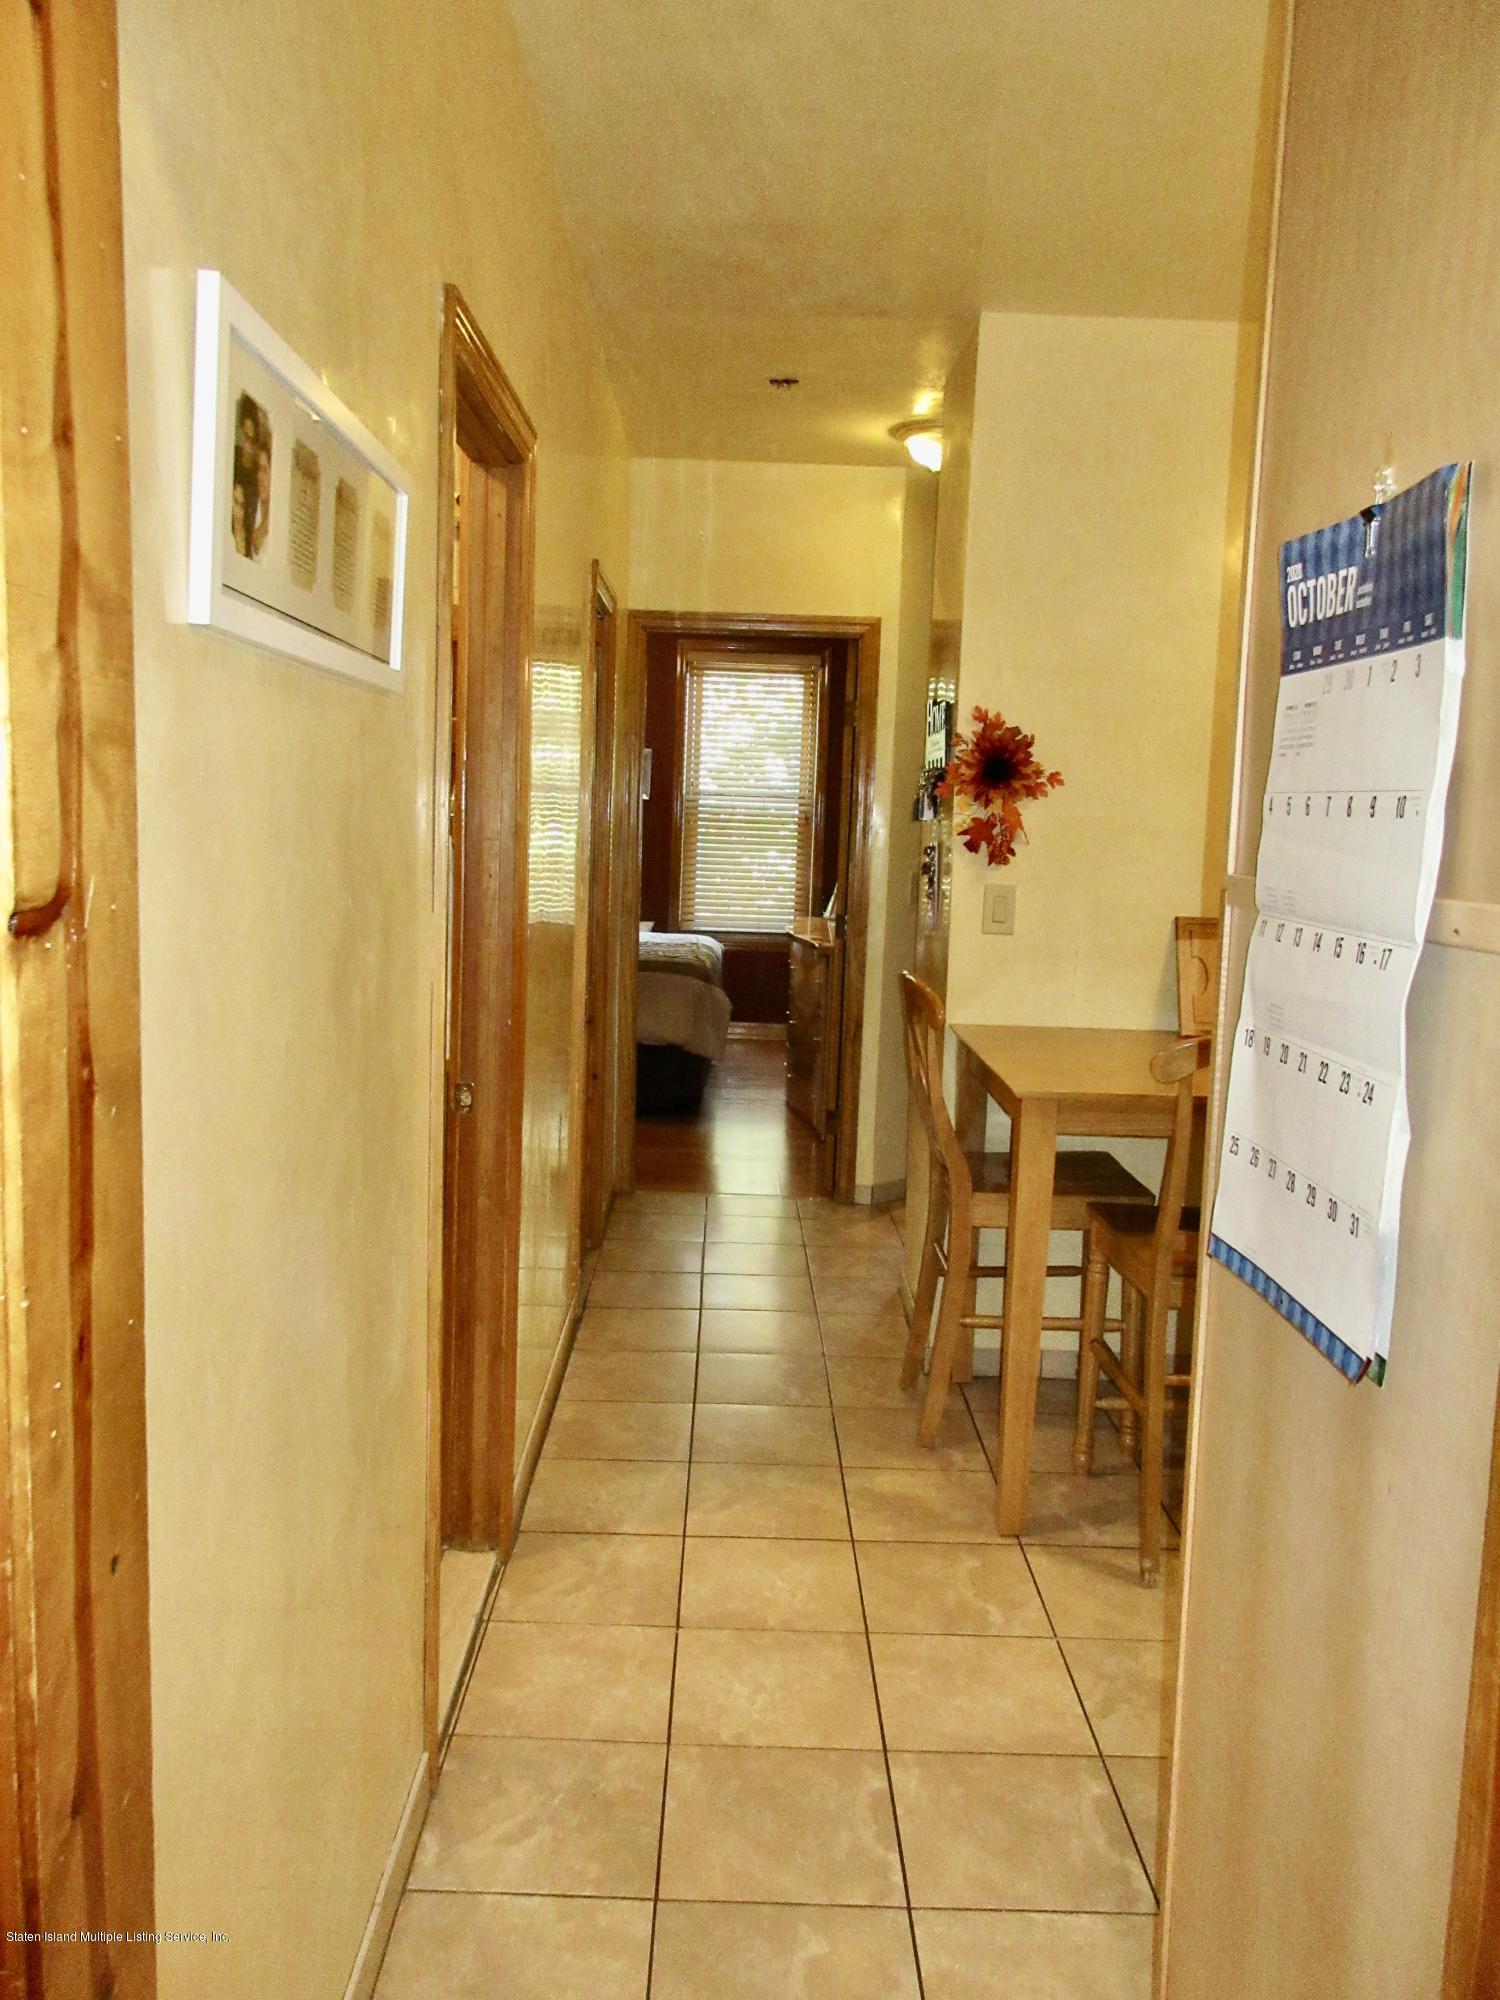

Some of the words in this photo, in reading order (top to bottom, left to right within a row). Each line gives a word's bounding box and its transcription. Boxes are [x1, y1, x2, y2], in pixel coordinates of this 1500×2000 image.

[1287, 566, 1358, 628] OCTOBER
[1367, 664, 1373, 687] 1
[1390, 659, 1398, 683] 2
[1414, 653, 1422, 678] 3
[1268, 796, 1274, 815] 4
[1286, 796, 1292, 816] 5
[1305, 796, 1311, 816] 6
[1326, 795, 1332, 817] 7
[1346, 795, 1354, 818] 8
[1369, 795, 1377, 818] 9
[1396, 795, 1407, 819] 10
[1259, 919, 1268, 938] 11
[1275, 922, 1285, 943] 12
[1293, 927, 1303, 947] 13
[1312, 932, 1323, 952] 14
[1333, 936, 1344, 959] 15
[1355, 941, 1367, 964] 16
[1379, 947, 1393, 970] 17
[1244, 1028, 1255, 1048] 18
[1263, 1036, 1271, 1056] 19
[1279, 1043, 1289, 1065] 20
[1297, 1051, 1307, 1074] 21
[1317, 1060, 1329, 1084] 22
[1339, 1070, 1351, 1095] 23
[1362, 1080, 1375, 1106] 24
[1229, 1135, 1240, 1156] 25
[1249, 1146, 1260, 1168] 26
[1268, 1158, 1277, 1180] 27
[1285, 1170, 1296, 1193] 28
[1306, 1183, 1316, 1207] 29
[1327, 1197, 1338, 1222] 30
[1349, 1212, 1360, 1238] 31
